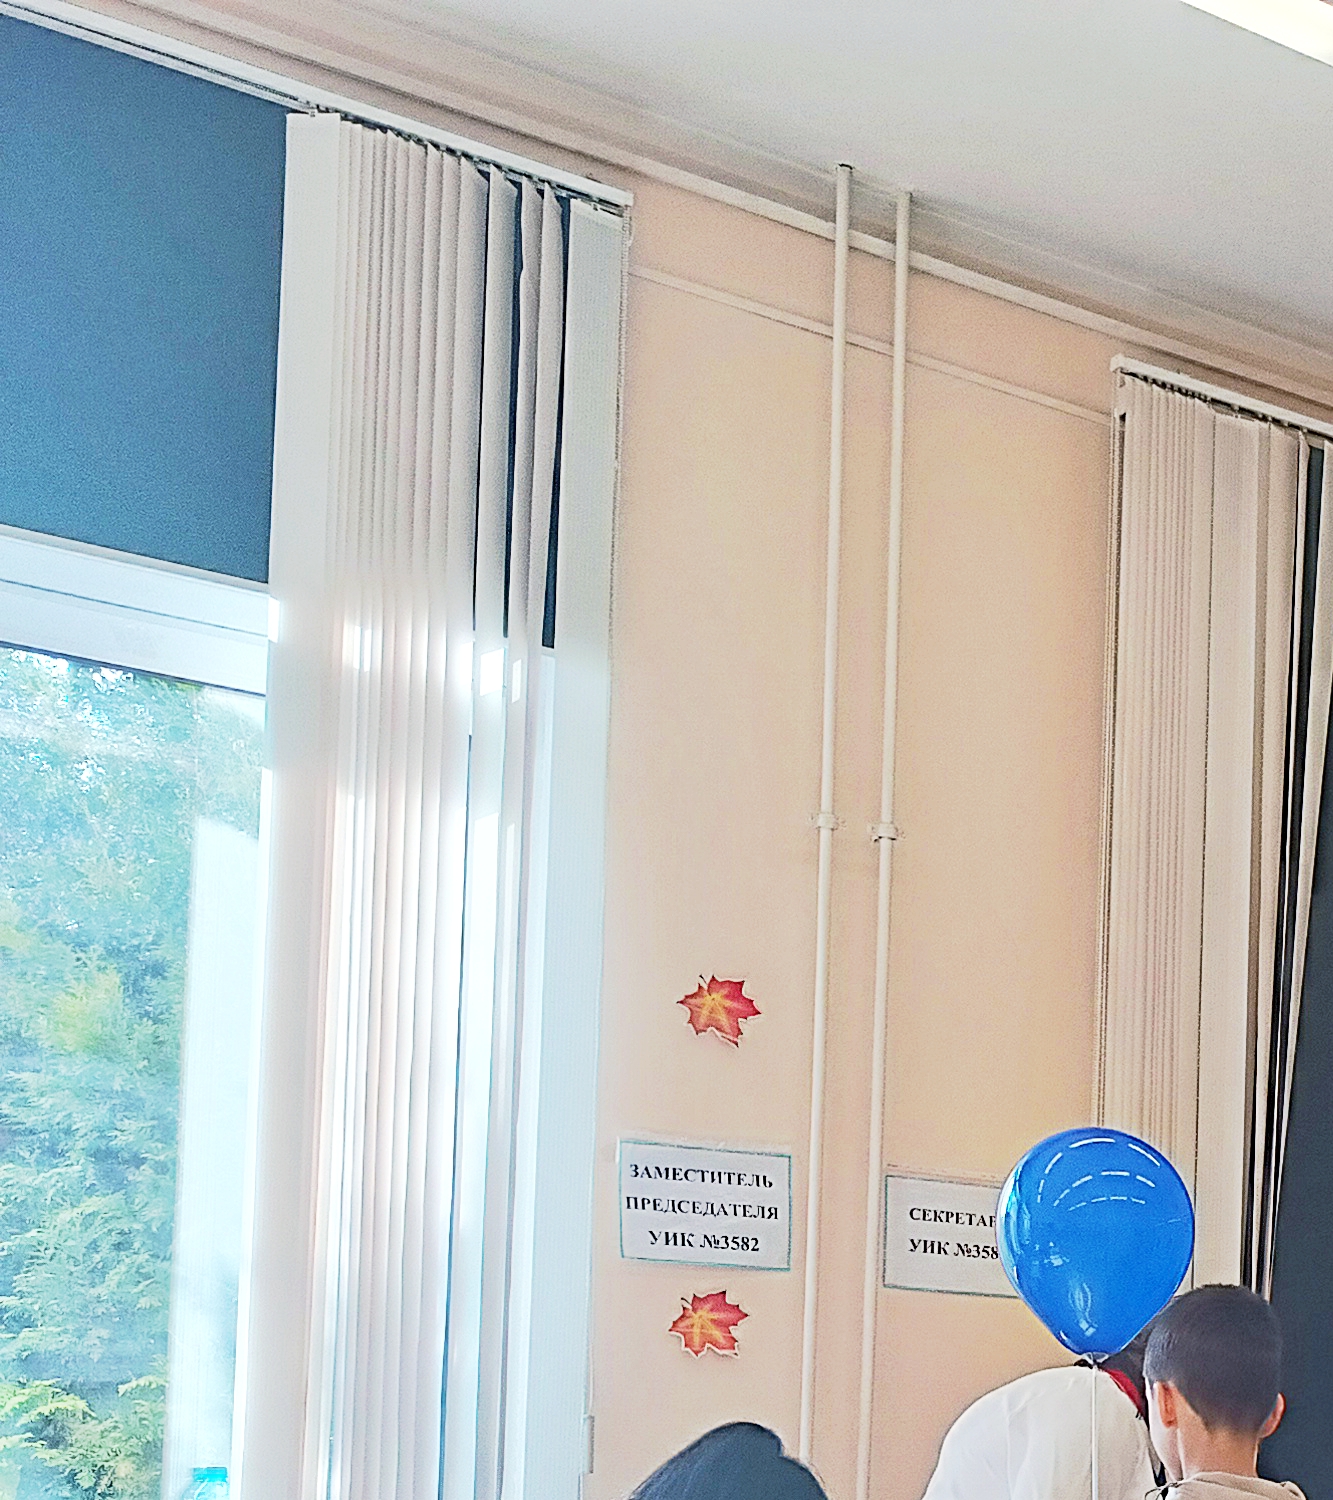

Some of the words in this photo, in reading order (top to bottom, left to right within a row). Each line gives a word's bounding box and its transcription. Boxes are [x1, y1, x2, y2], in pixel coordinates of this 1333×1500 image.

[629, 1163, 773, 1188] ЗАМЕСТИТЕЛЬ
[625, 1196, 779, 1220] ПРЕДСЕДАТЕЛЯ
[909, 1207, 996, 1228] СЕКРЕТАР
[648, 1230, 695, 1248] УИК
[699, 1234, 760, 1252] №3582
[908, 1238, 950, 1256] УИК
[953, 1242, 999, 1260] №358
